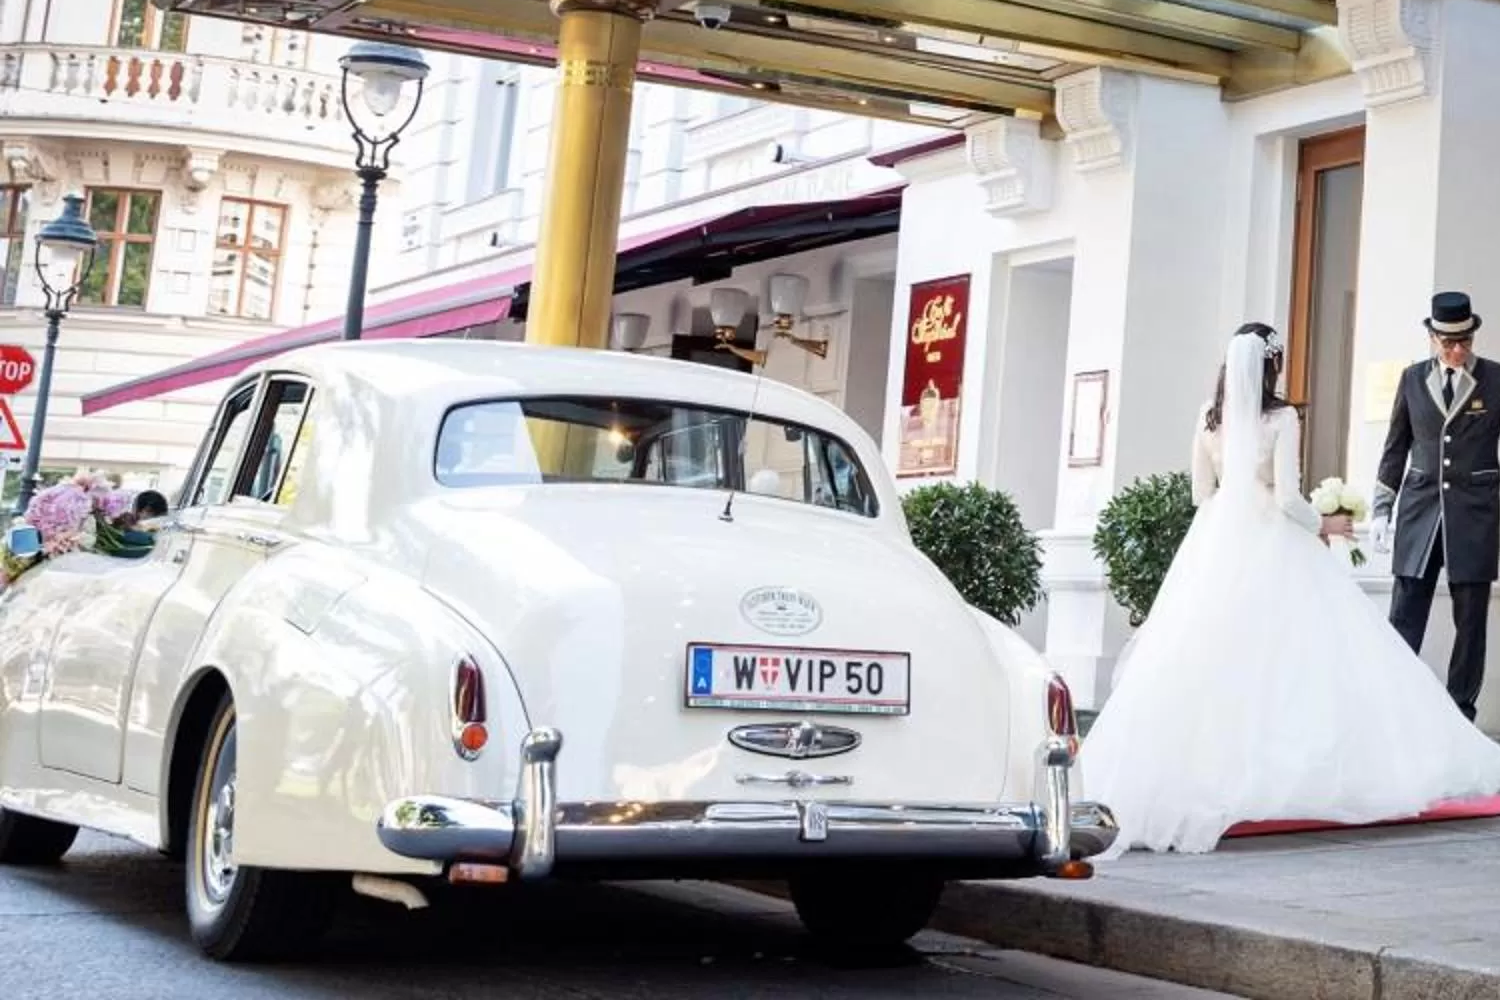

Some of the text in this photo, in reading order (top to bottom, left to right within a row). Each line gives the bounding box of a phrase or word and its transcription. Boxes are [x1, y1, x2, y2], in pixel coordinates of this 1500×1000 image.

[0, 360, 31, 381] TOP
[697, 655, 884, 695] A W VIP 50
